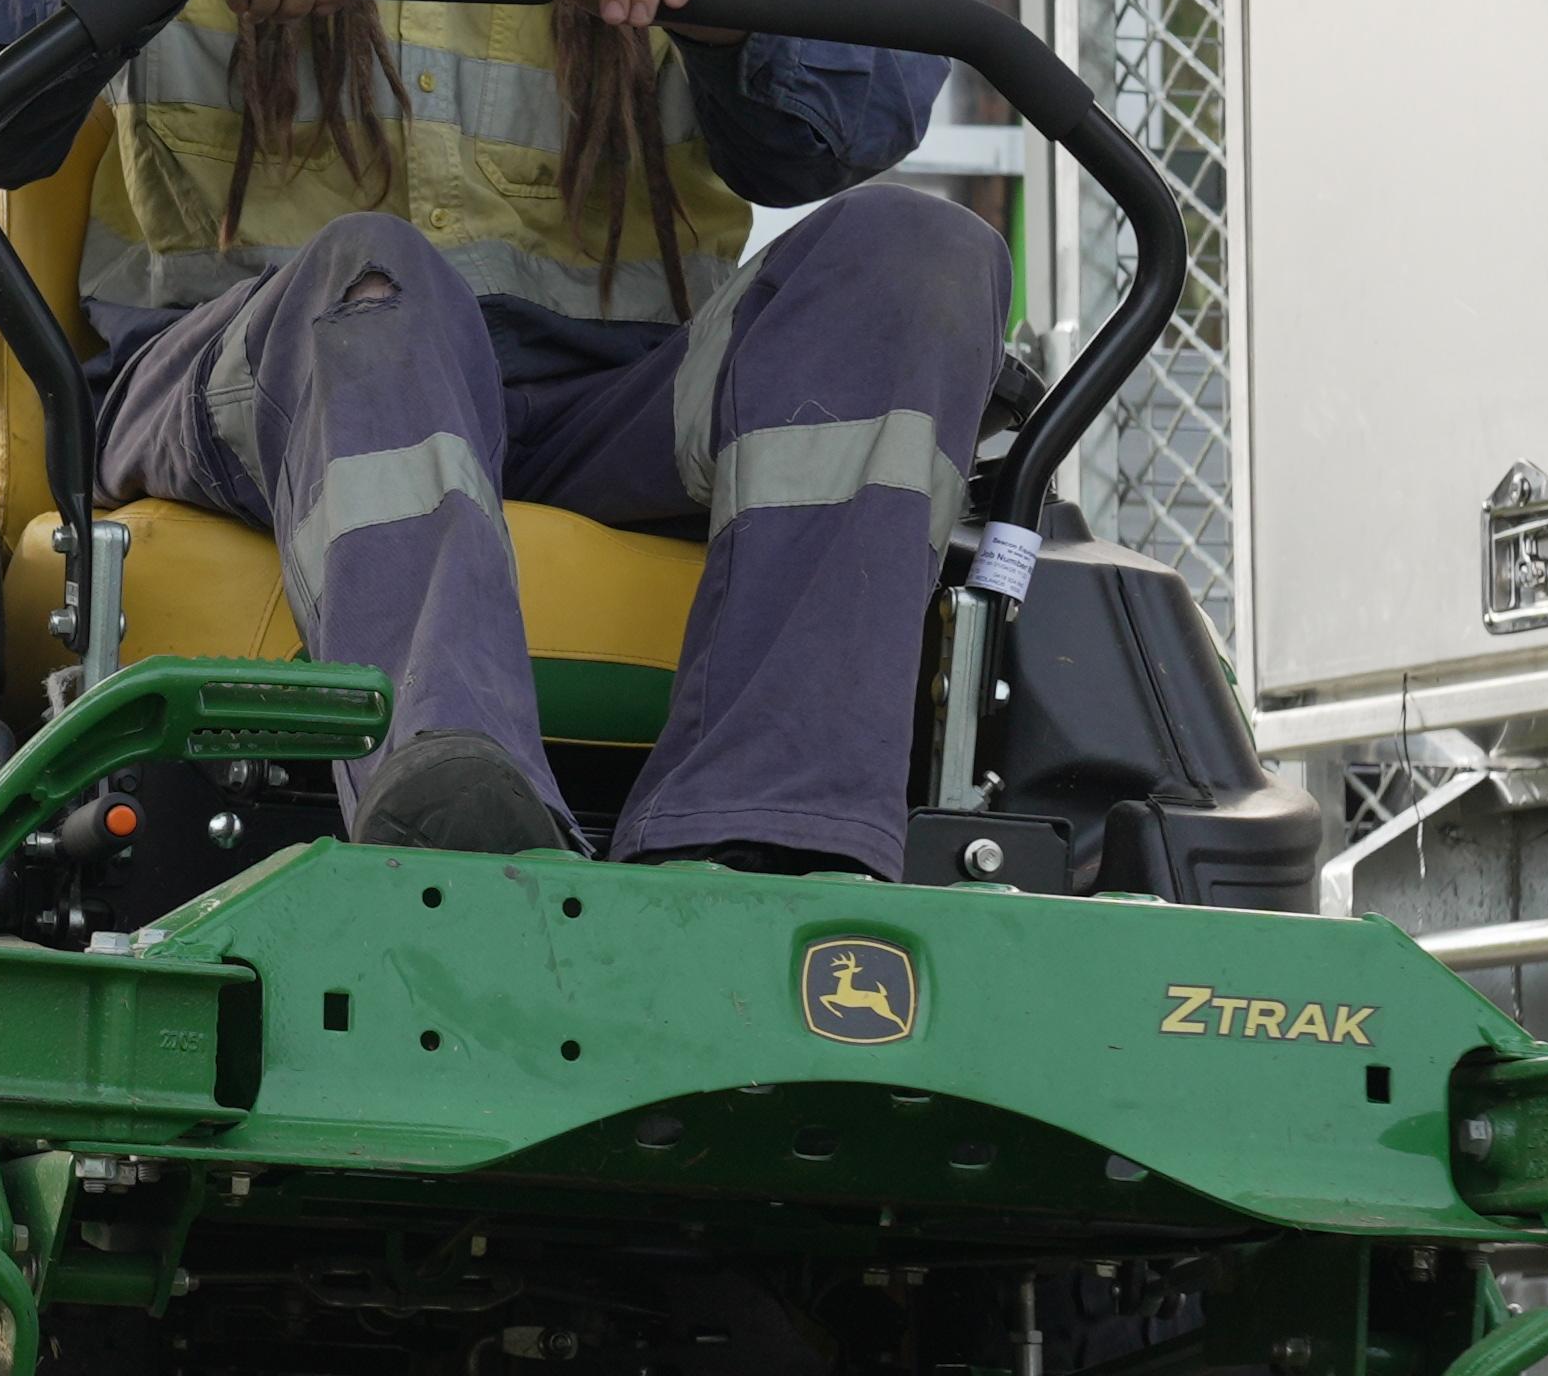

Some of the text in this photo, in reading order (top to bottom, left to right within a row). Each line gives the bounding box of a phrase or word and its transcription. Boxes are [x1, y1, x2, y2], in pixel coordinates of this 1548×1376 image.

[980, 549, 995, 559] Job
[996, 553, 1027, 570] Number
[1159, 984, 1382, 1047] ZTRAK
